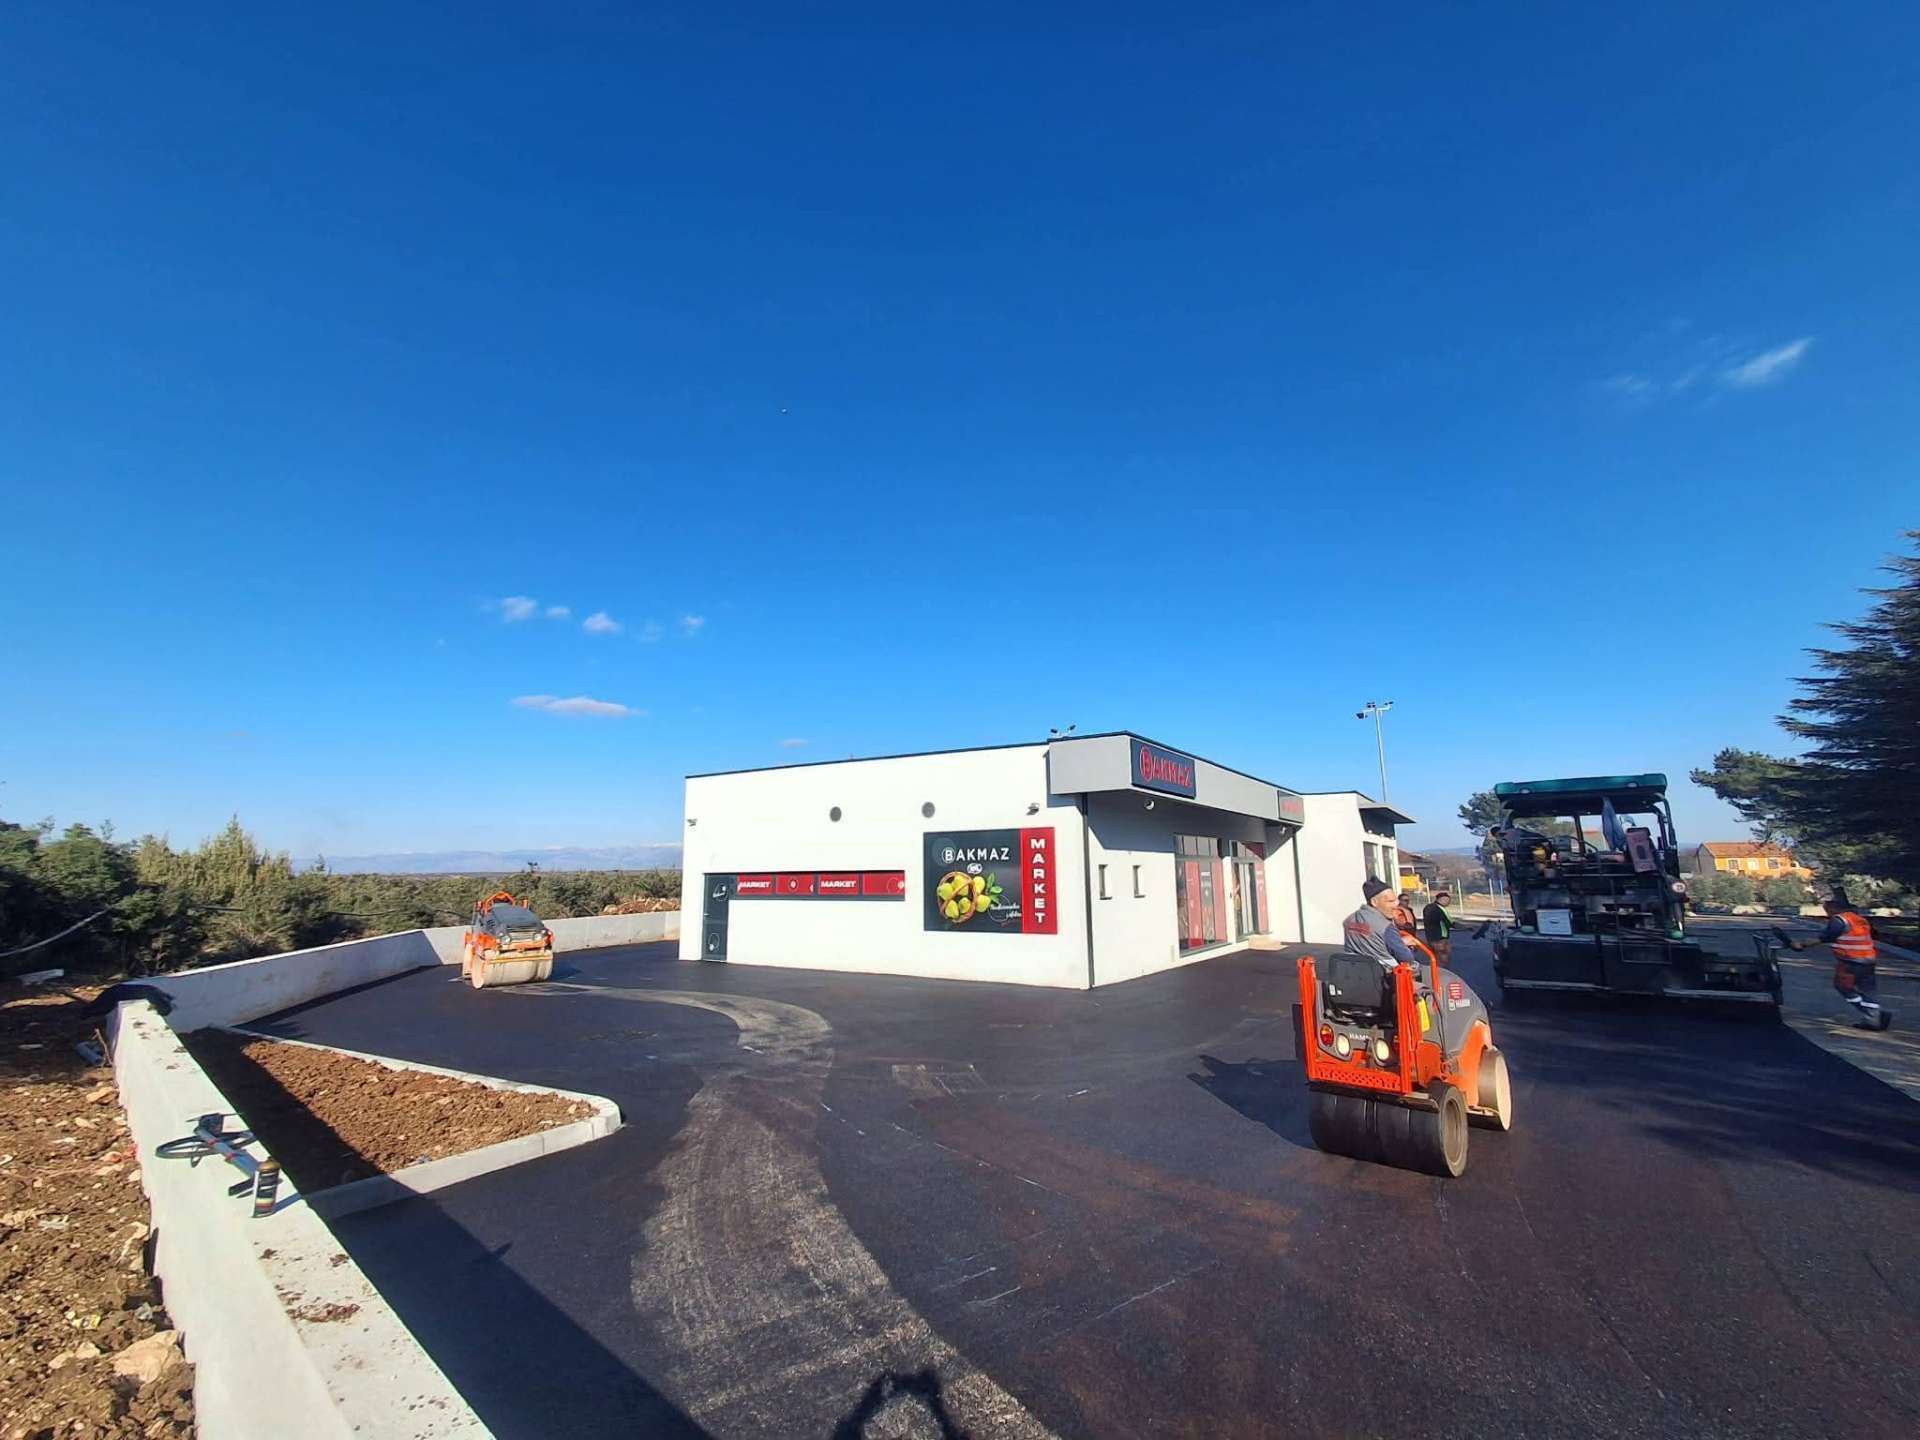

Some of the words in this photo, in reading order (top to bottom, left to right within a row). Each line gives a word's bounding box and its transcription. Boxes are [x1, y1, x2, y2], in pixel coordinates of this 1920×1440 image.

[1140, 744, 1192, 788] BAKMAZ
[942, 847, 1010, 863] BAKMAZ
[739, 880, 771, 889] MARKET
[820, 880, 856, 888] MARKET
[1030, 838, 1046, 923] MARKET
